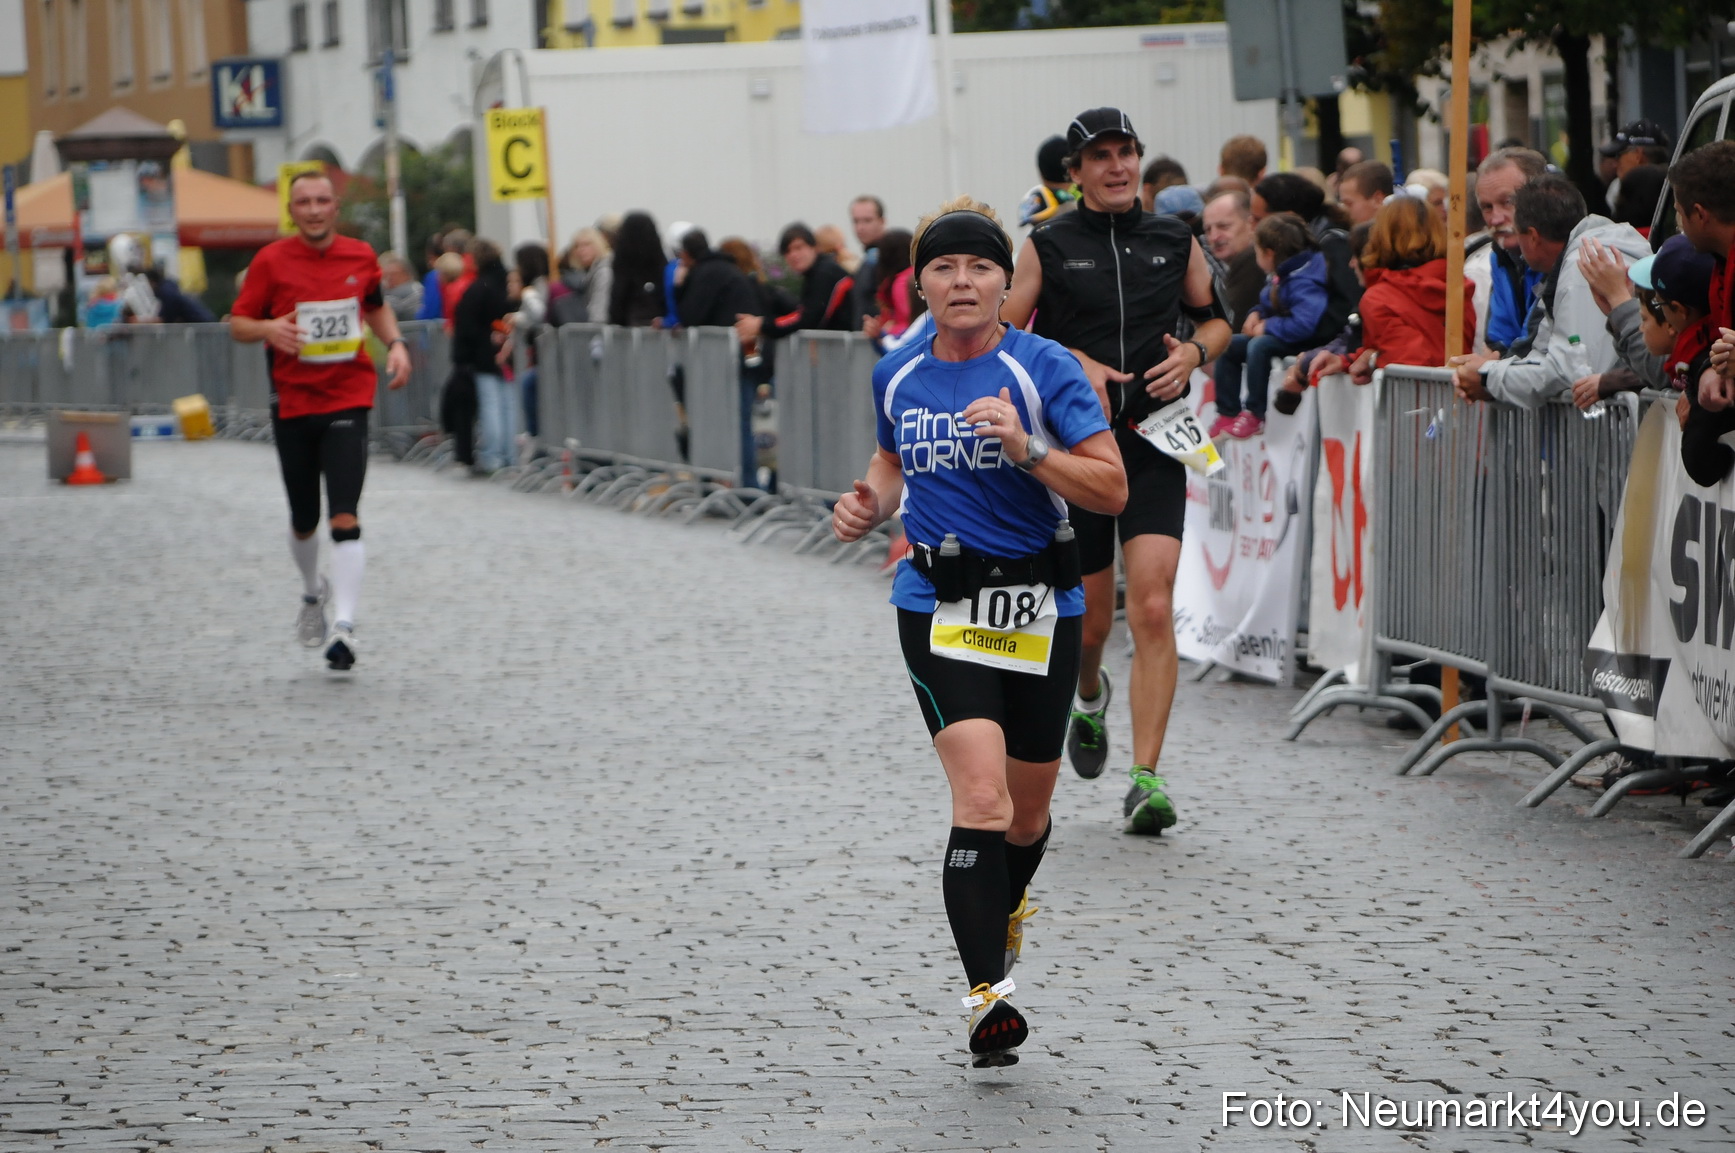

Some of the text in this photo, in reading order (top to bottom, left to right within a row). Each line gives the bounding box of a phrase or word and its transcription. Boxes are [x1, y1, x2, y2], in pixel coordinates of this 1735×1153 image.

[502, 135, 532, 179] C
[311, 314, 349, 339] 323
[1164, 416, 1202, 452] 416
[970, 590, 1036, 629] 108
[962, 629, 1017, 653] Claudia
